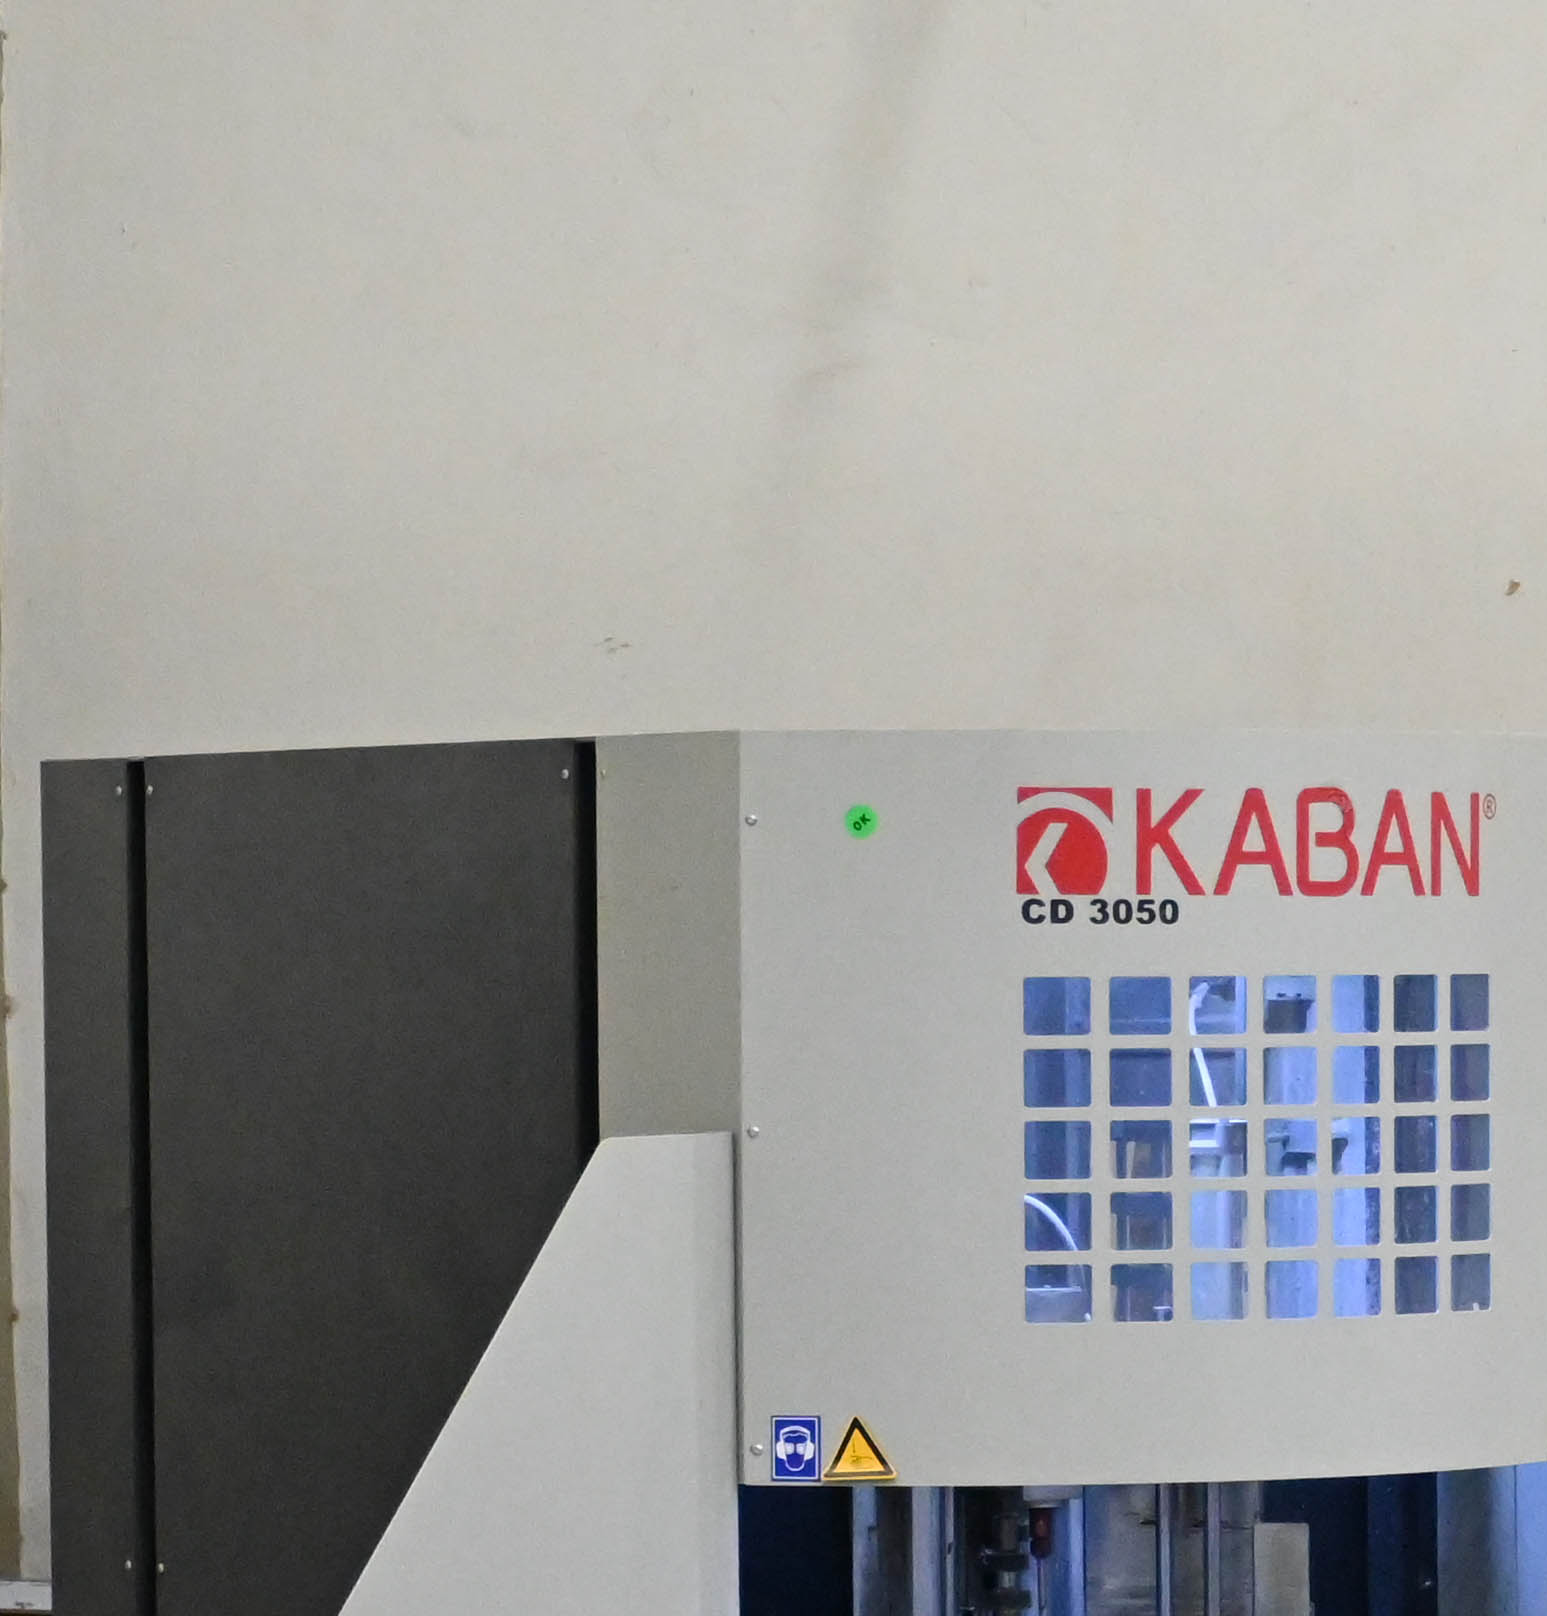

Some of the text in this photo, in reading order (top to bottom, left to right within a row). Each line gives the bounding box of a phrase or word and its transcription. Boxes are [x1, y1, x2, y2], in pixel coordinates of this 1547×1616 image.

[853, 813, 871, 831] OK
[1135, 787, 1481, 896] KABAN
[1021, 898, 1179, 925] CD 3050
